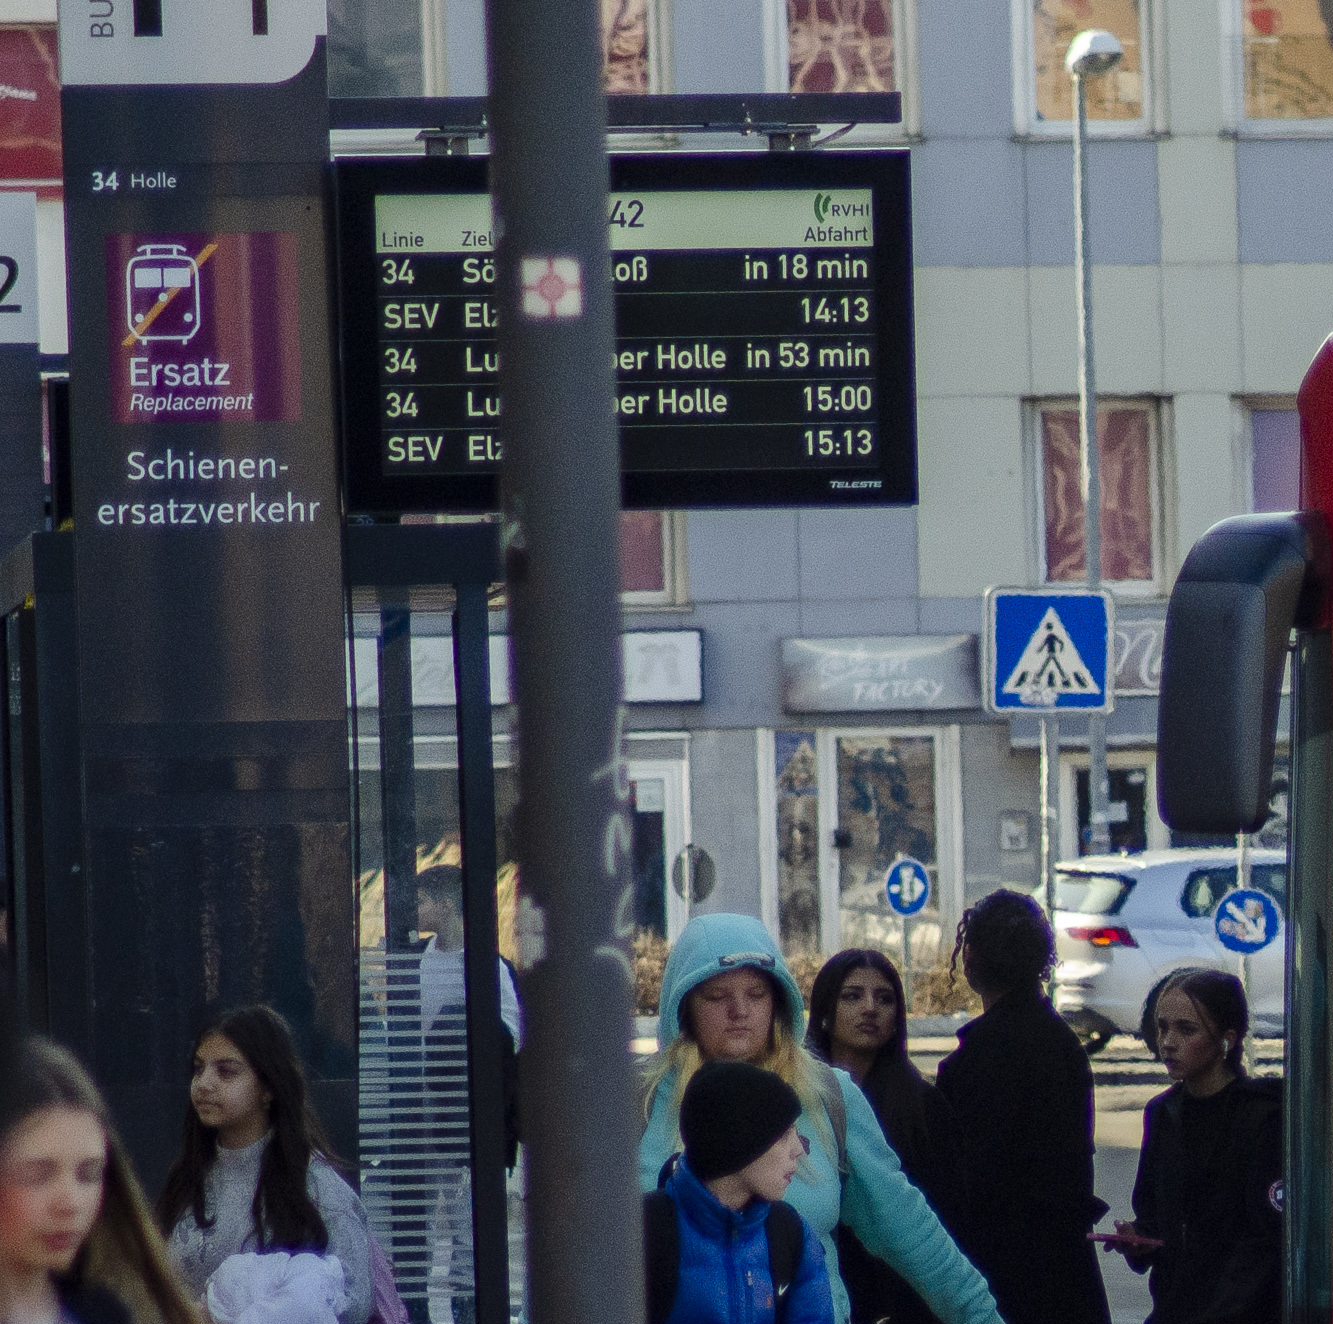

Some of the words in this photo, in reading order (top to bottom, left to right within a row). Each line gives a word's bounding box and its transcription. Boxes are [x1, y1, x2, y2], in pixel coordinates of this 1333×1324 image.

[92, 171, 119, 191] 34
[131, 173, 177, 189] Holle
[831, 203, 870, 217] RVHI
[381, 231, 424, 248] Linie
[461, 230, 494, 247] Ziel
[803, 226, 868, 242] Abfahrt
[382, 258, 415, 285] 34
[745, 254, 768, 280] in
[778, 253, 808, 279] 18
[817, 253, 868, 279] min
[384, 302, 440, 330] SEV
[801, 297, 870, 324] 14:13
[129, 357, 231, 387] Ersatz
[384, 347, 417, 374] 34
[657, 343, 728, 370] Holle
[746, 342, 770, 369] in
[779, 342, 810, 368] 53
[818, 342, 870, 368] min
[129, 393, 255, 412] Replacement
[386, 391, 419, 418] 34
[658, 387, 728, 414] Holle
[803, 385, 872, 412] 15:00
[387, 436, 443, 462] SEV
[804, 429, 873, 456] 15:13
[127, 449, 289, 481] Schienen-
[829, 480, 883, 489] TELESTE
[97, 491, 321, 525] ersatzverkehr
